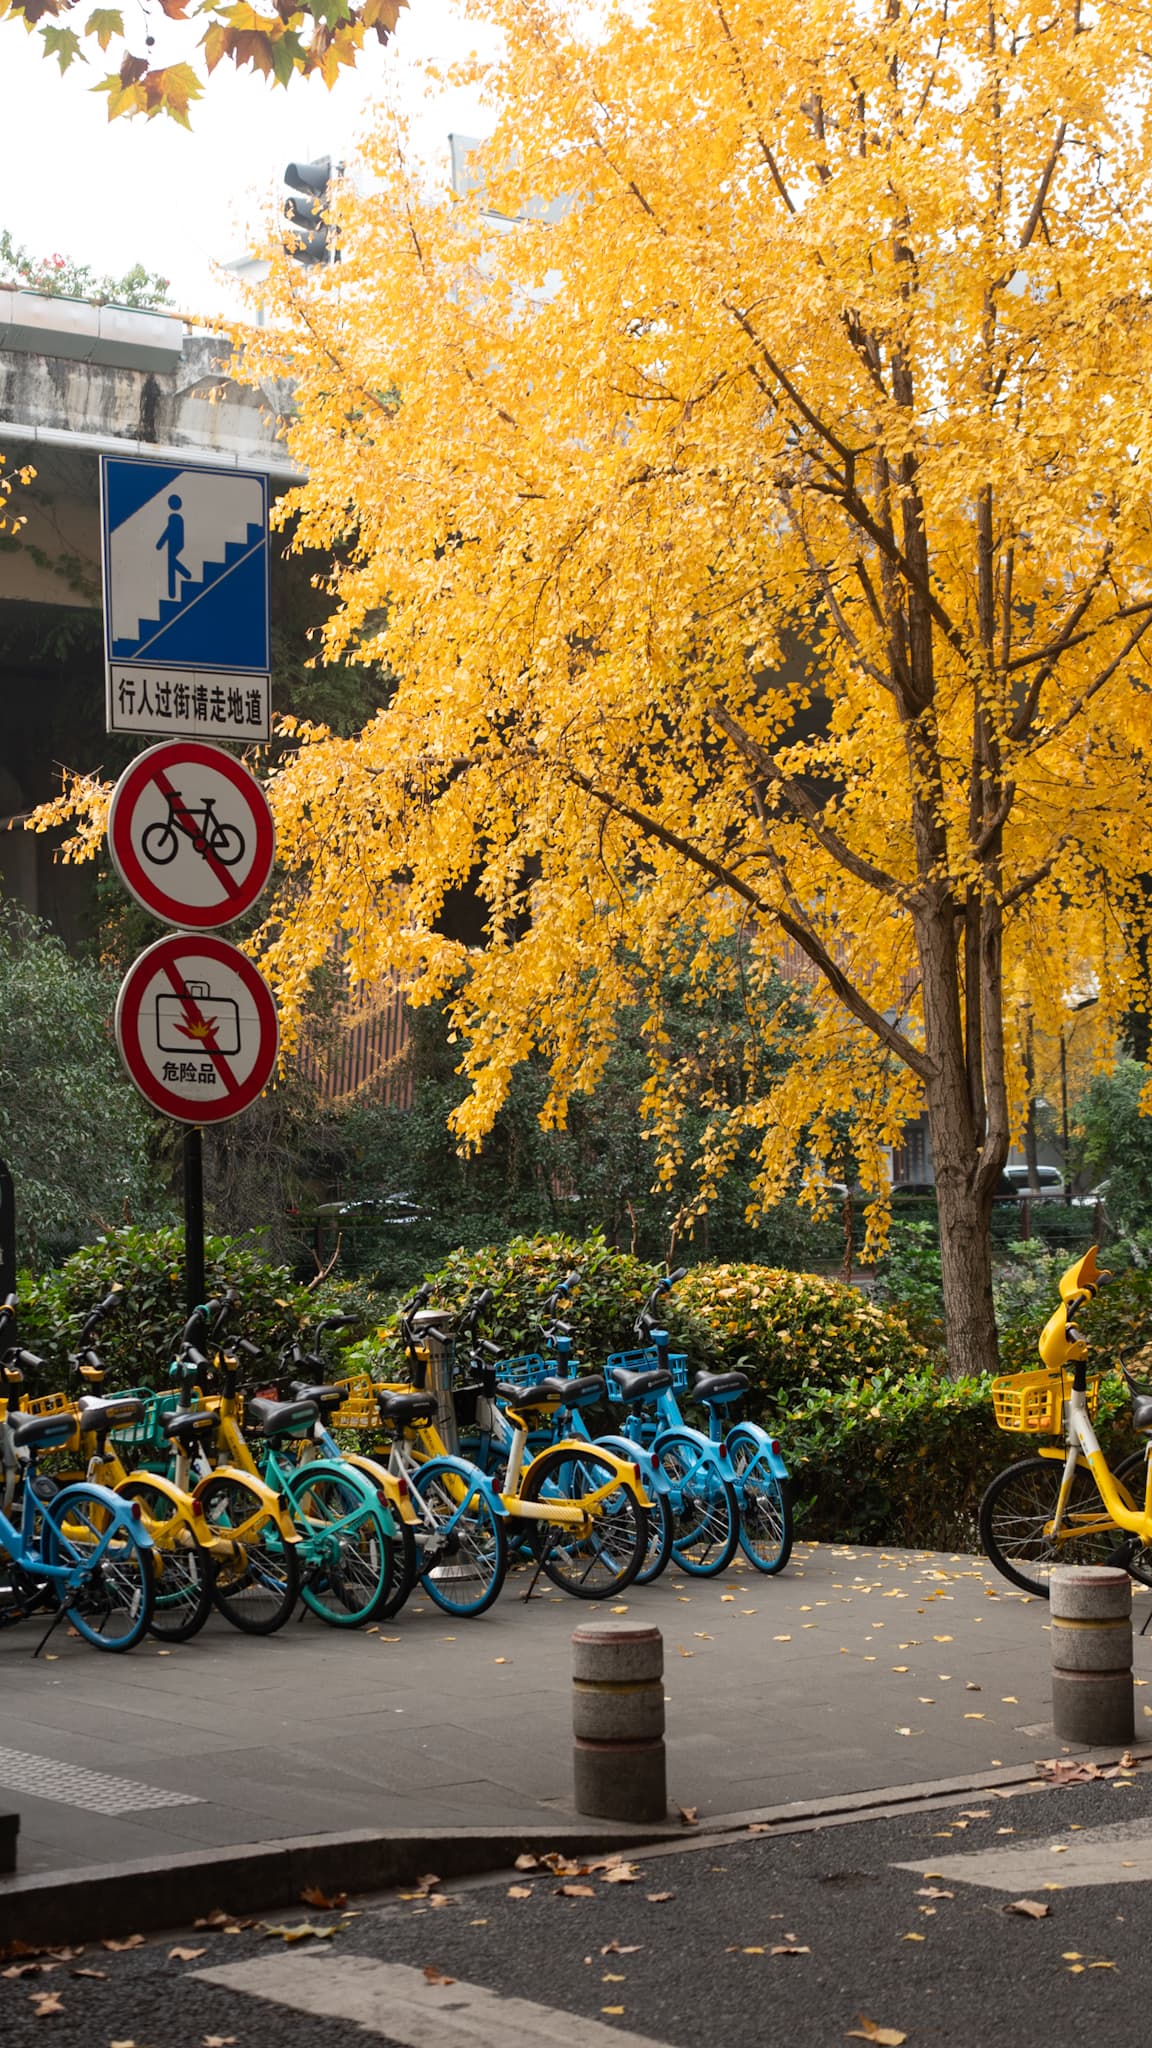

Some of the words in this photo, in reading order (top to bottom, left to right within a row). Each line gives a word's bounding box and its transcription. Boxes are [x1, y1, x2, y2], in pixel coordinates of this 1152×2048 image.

[118, 678, 262, 726] 行人过街请走地道
[162, 1061, 216, 1084] 危险品
